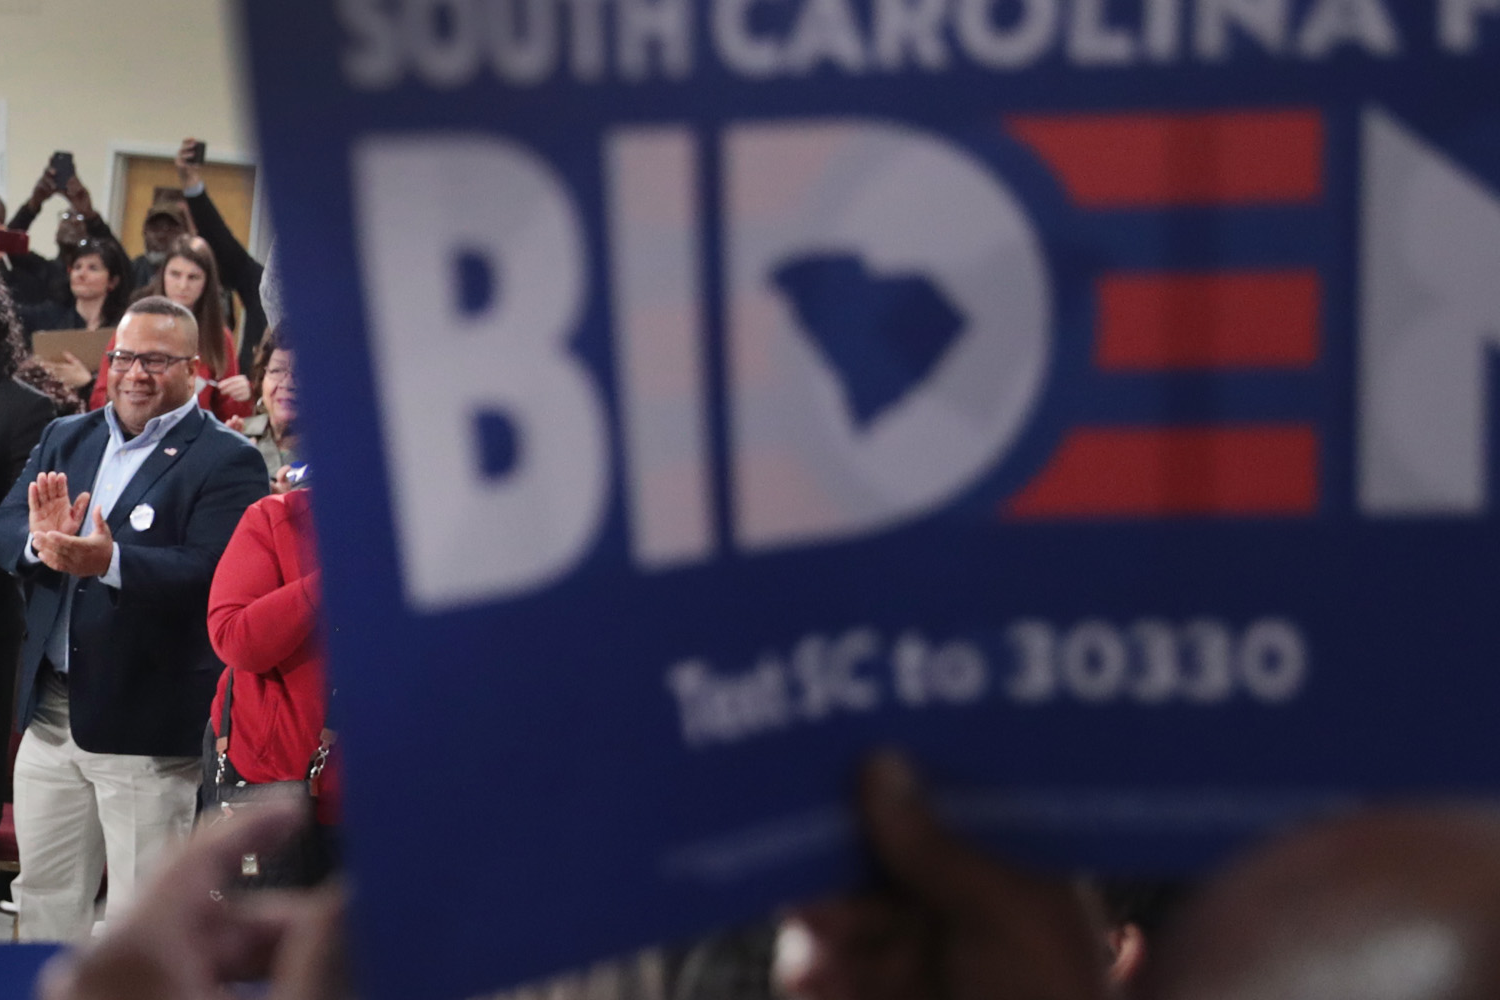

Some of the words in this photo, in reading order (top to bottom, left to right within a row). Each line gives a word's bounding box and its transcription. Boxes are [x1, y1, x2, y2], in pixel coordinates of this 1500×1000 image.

[338, 0, 693, 90] SOUTH
[793, 630, 880, 722] SC
[893, 632, 987, 706] to
[1006, 617, 1306, 704] 30330
